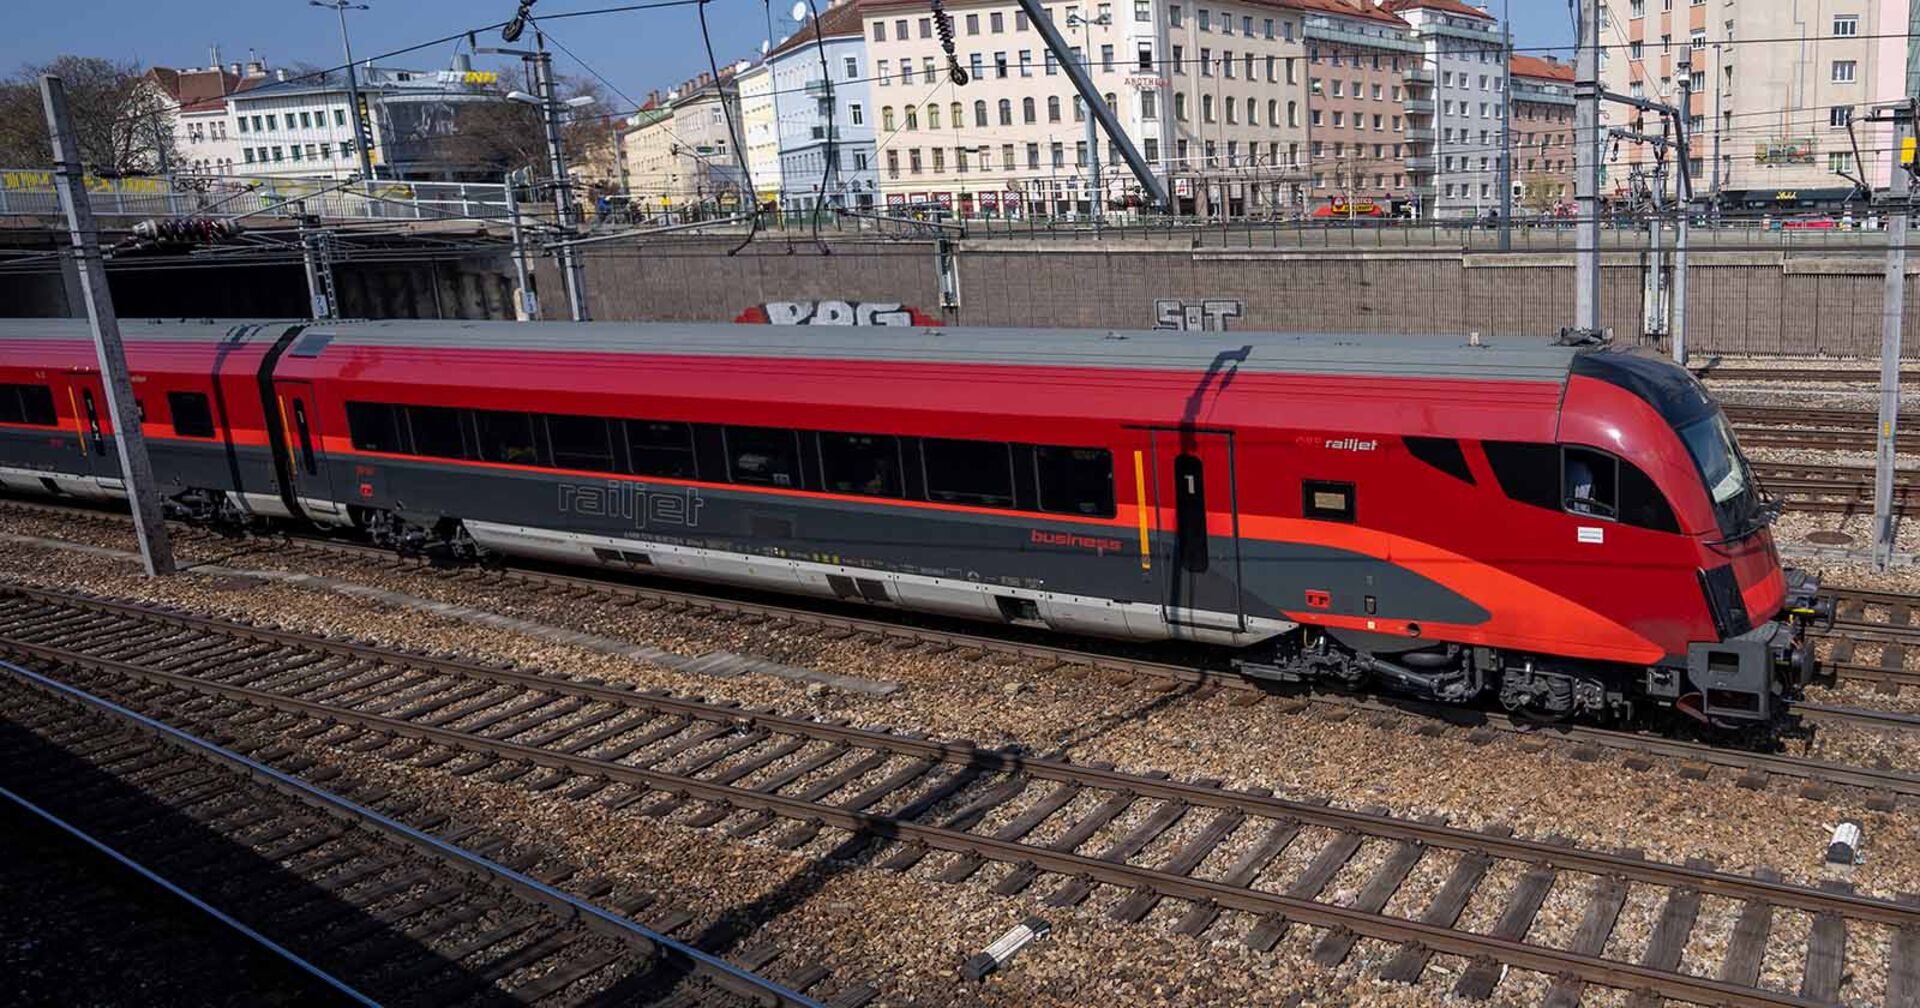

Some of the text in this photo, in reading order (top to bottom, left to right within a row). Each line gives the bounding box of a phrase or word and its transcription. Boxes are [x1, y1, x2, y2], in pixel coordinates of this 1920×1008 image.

[1325, 438, 1378, 452] railjet
[1183, 474, 1196, 495] 1
[557, 480, 704, 529] railjet
[1030, 528, 1122, 552] business
